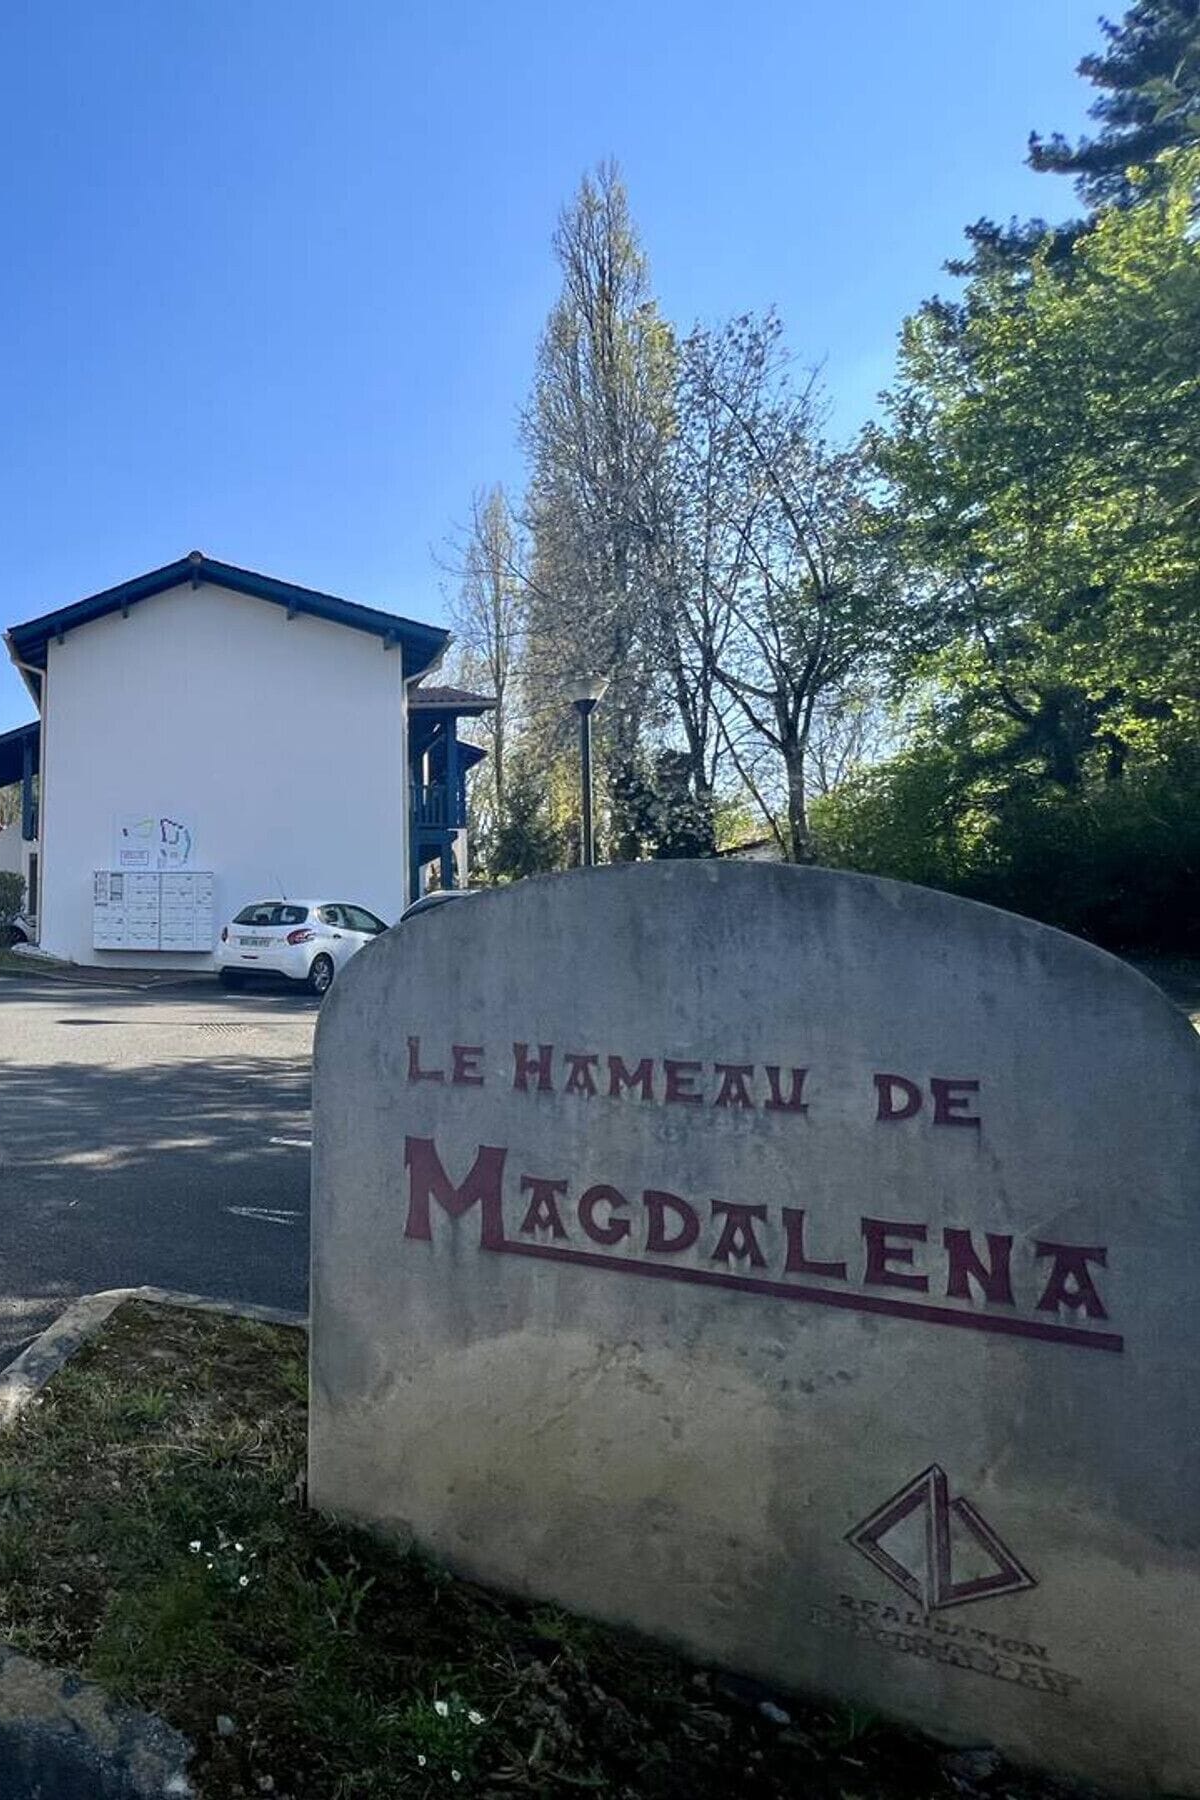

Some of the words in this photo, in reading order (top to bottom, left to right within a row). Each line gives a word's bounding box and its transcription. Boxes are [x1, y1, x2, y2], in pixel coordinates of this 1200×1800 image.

[406, 1035, 485, 1087] LE
[512, 1042, 809, 1113] HAMEAU
[873, 1073, 981, 1128] DE
[404, 1135, 1108, 1320] MAGDALENA
